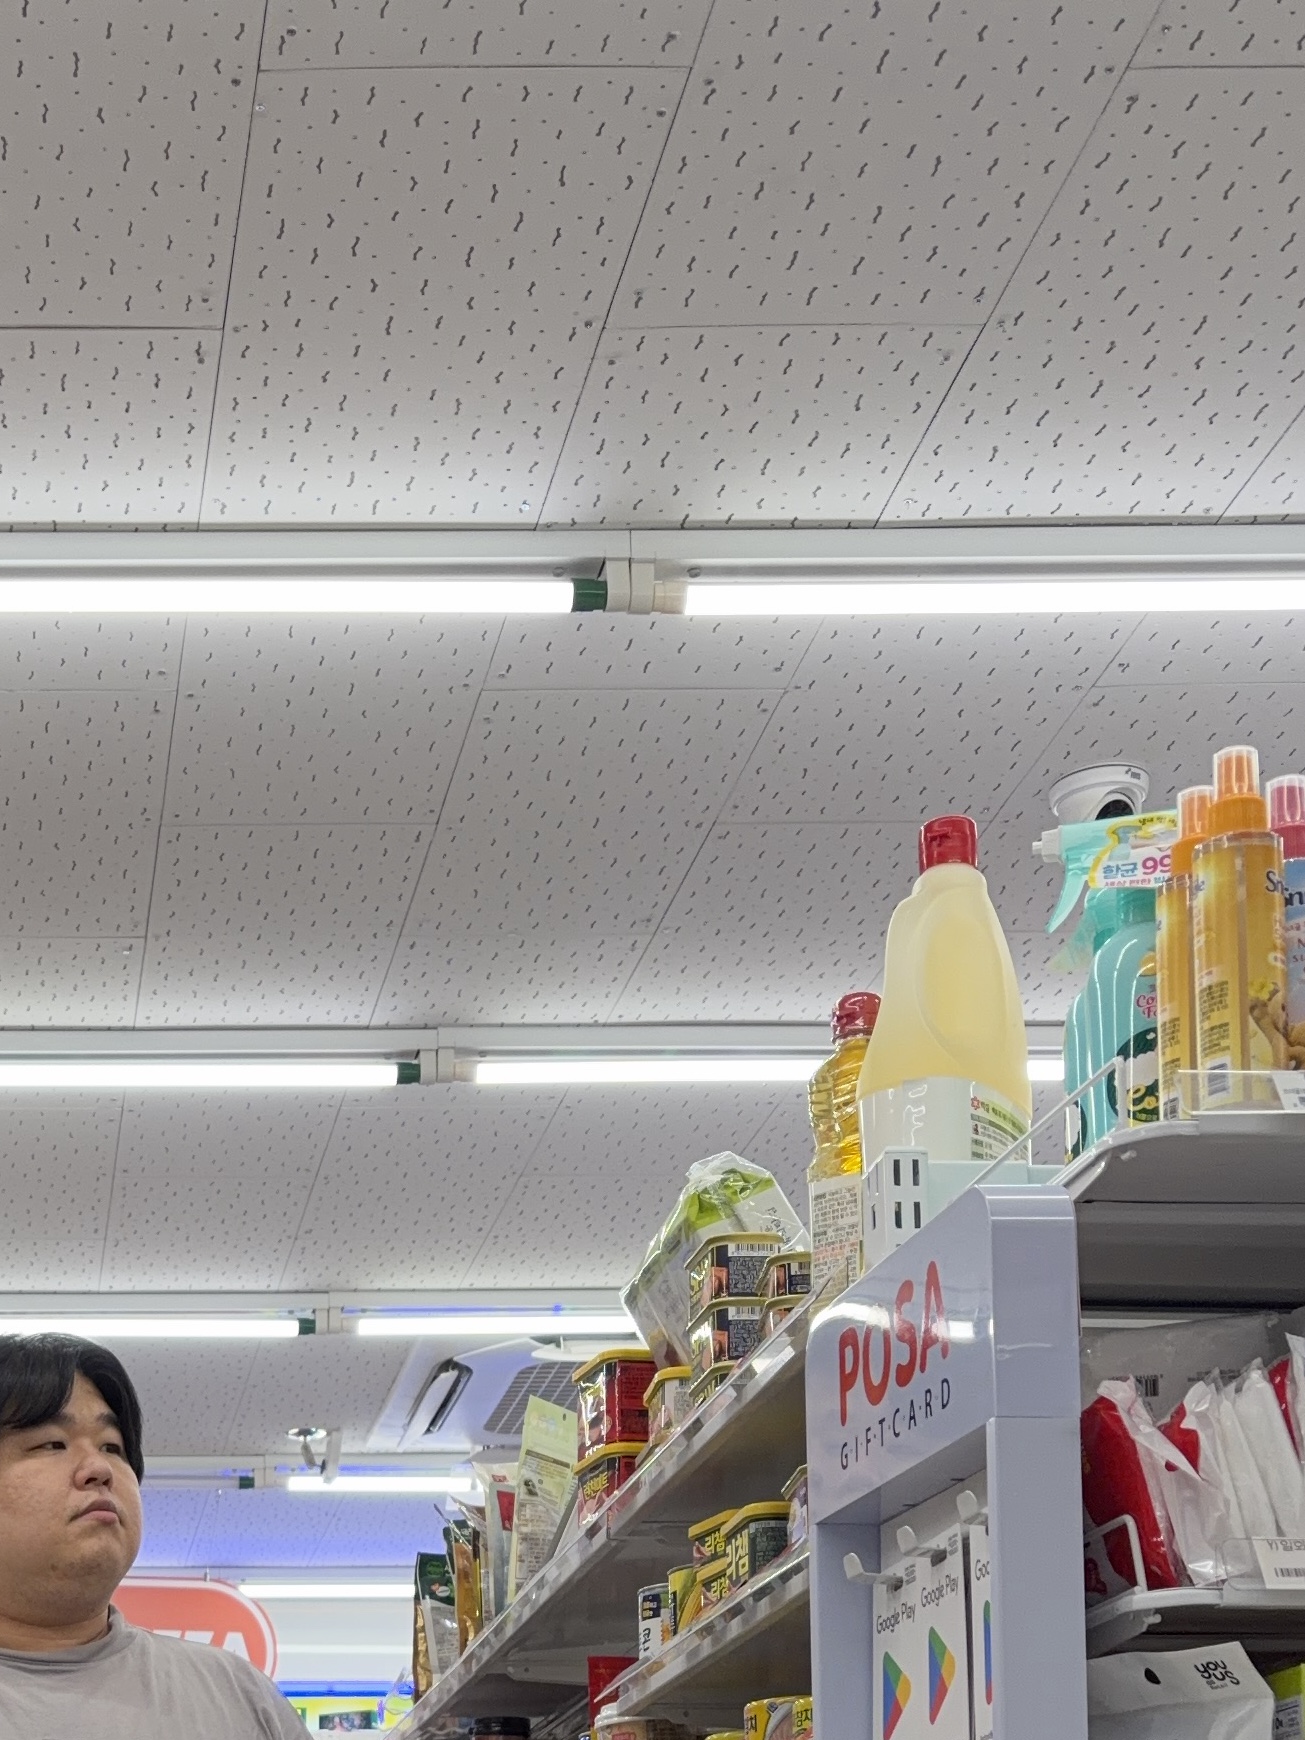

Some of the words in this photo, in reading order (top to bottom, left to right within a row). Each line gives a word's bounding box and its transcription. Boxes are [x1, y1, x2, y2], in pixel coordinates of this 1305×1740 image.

[838, 1260, 950, 1427] POSA
[920, 1579, 945, 1608] Google
[876, 1607, 901, 1635] Google
